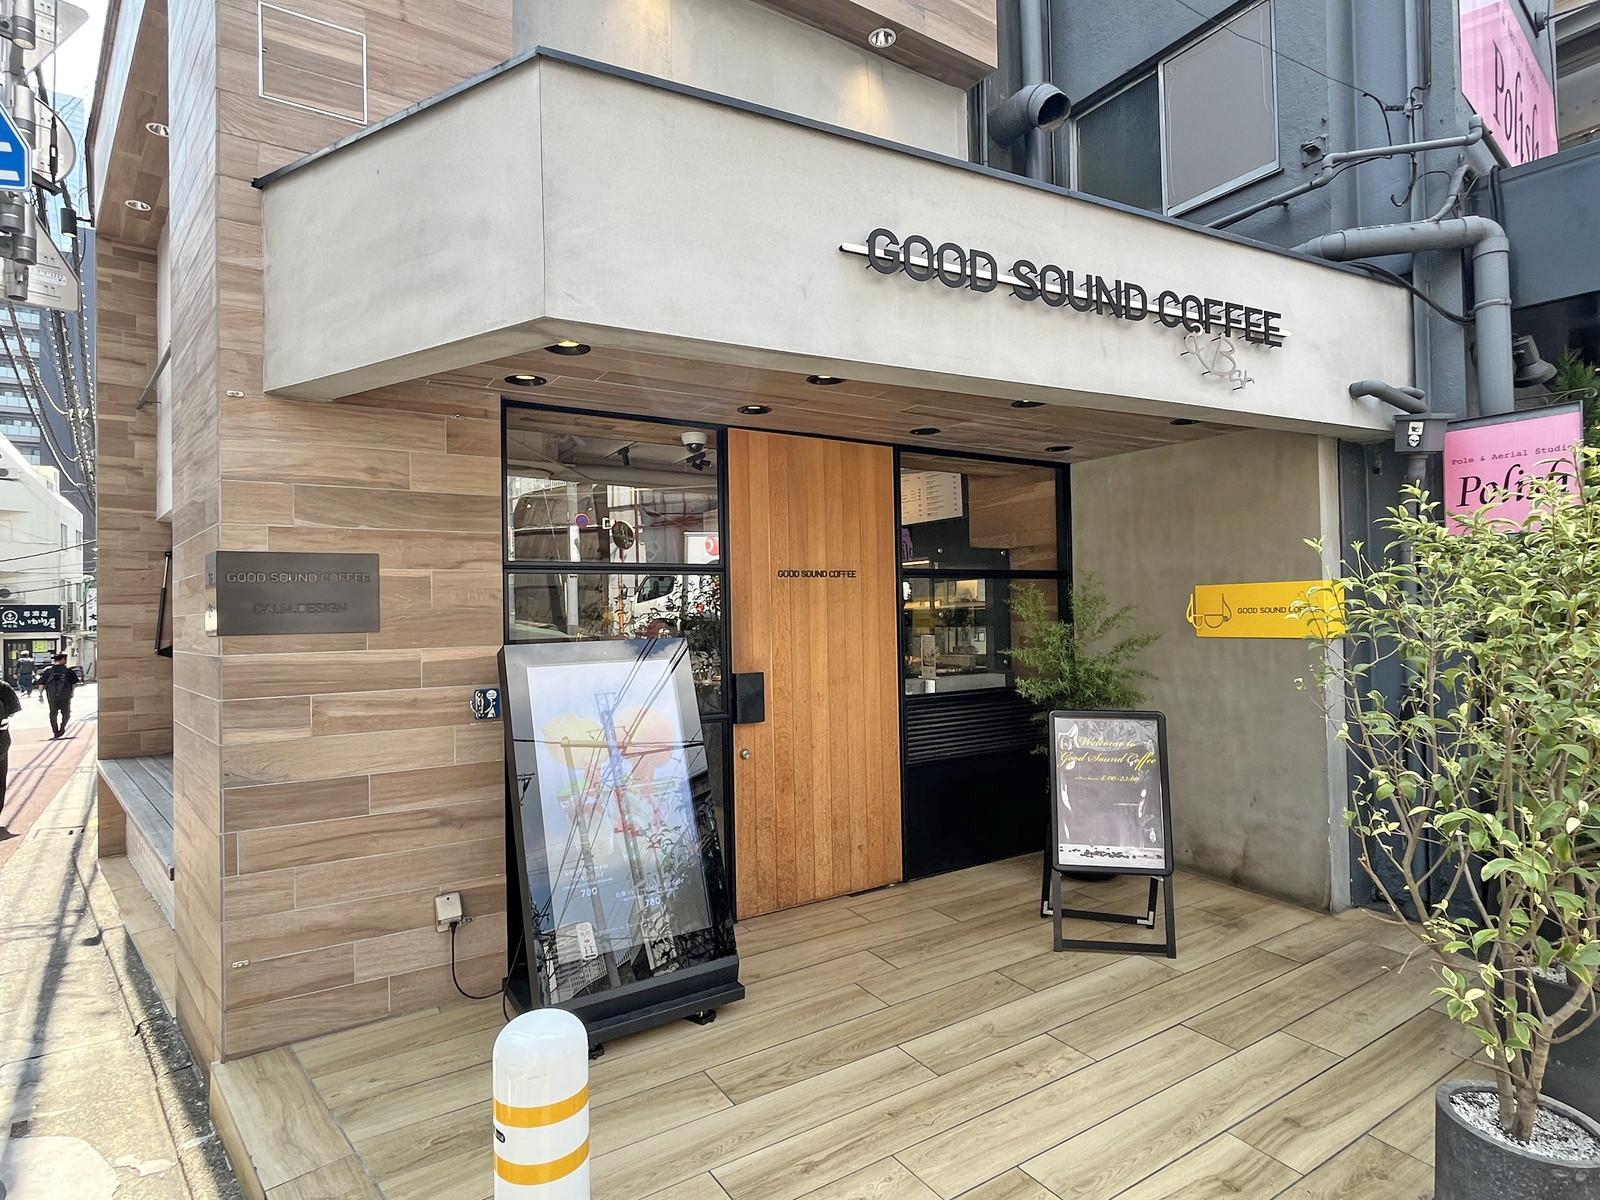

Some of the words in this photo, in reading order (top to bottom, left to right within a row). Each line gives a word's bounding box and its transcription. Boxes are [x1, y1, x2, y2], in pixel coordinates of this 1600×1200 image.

[867, 227, 998, 293] GOOD
[1012, 258, 1148, 322] SOUND
[1158, 289, 1284, 348] COFFEE
[1451, 457, 1475, 466] Pole
[1491, 449, 1529, 461] Aerial
[226, 571, 266, 584] GOOD
[270, 571, 317, 584] SOUND
[320, 571, 371, 584] COFFEE
[778, 569, 800, 578] GOOD
[801, 569, 828, 578] SOUND
[828, 569, 857, 578] COFFEE
[1237, 607, 1258, 615] GOOD
[1260, 606, 1287, 614] SOUND
[1078, 736, 1125, 748] Welcome
[1126, 737, 1136, 748] to
[1057, 751, 1088, 768] Good
[1086, 751, 1128, 764] Sound
[1126, 751, 1157, 771] Coffee
